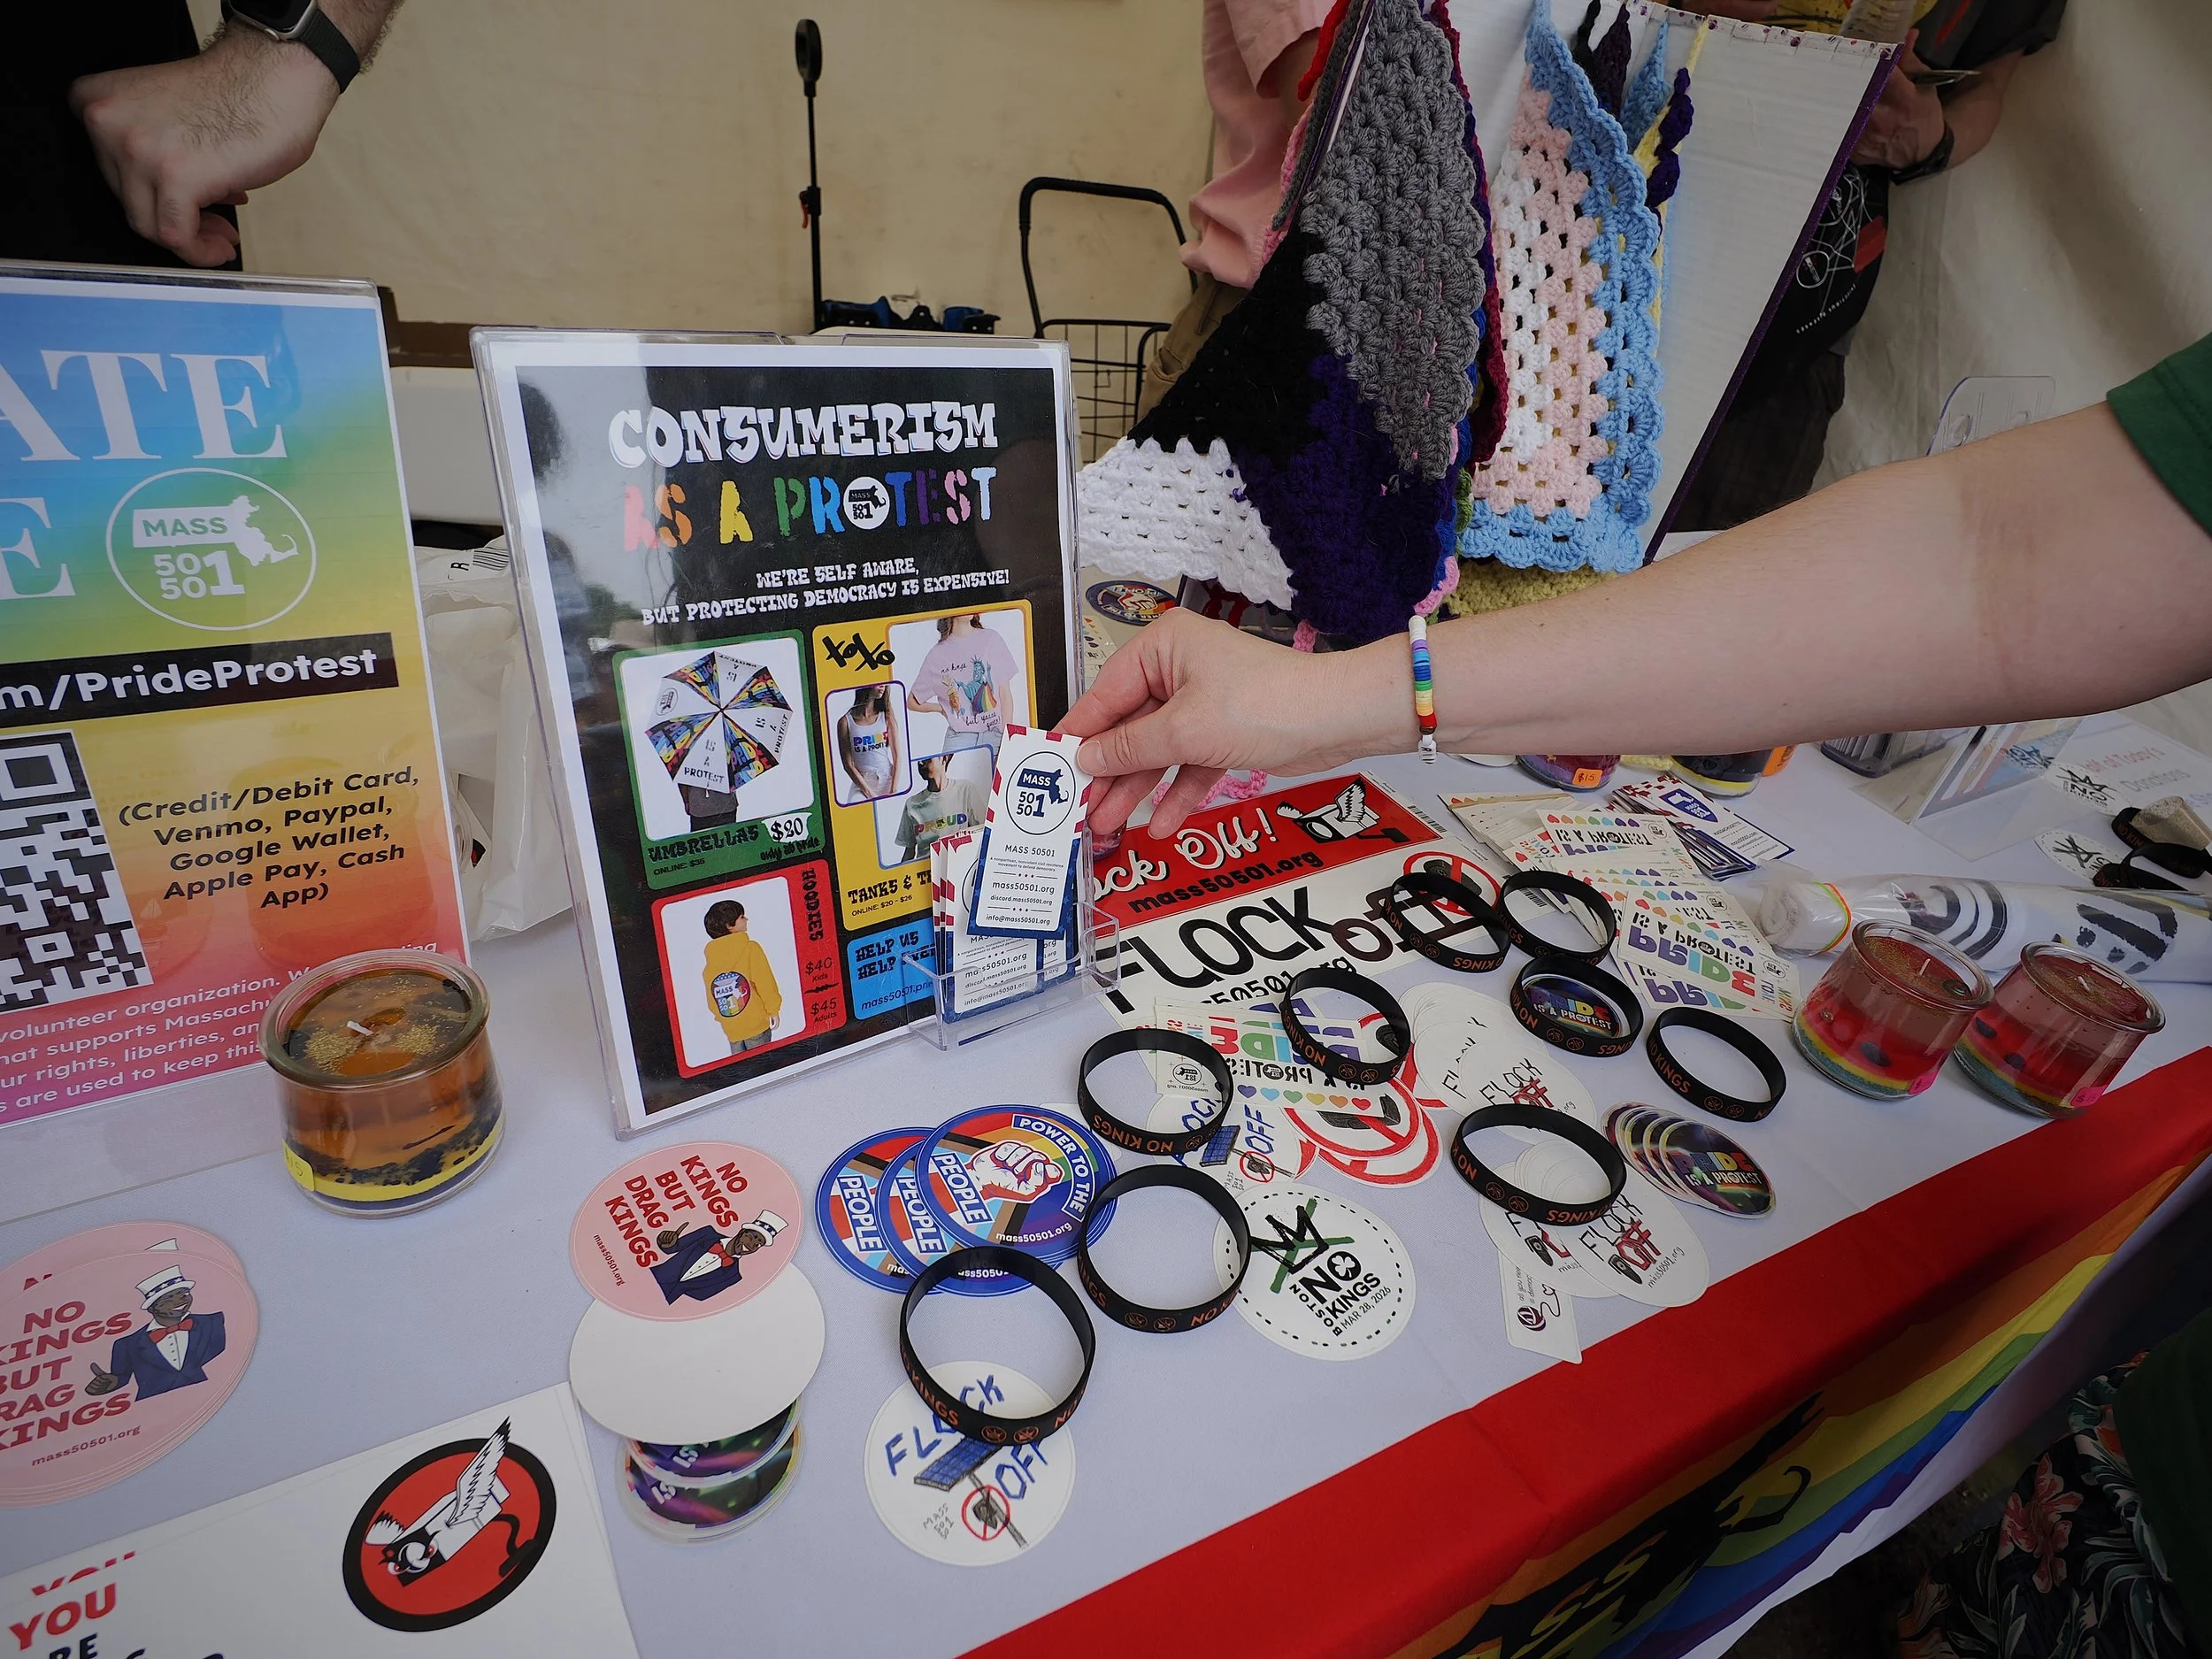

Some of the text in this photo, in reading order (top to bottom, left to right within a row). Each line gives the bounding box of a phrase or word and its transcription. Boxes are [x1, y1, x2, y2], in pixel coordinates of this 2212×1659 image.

[609, 400, 999, 468] CONSUMERISM
[142, 516, 228, 538] MASS
[624, 482, 693, 552] AS
[719, 480, 753, 545] A
[756, 557, 920, 589] WE'RE SELF AWARE,
[641, 568, 1010, 626] BUT PROTECTING DEMOCRACY IS EXPENSIVE!
[119, 765, 419, 827] (Credit/Debit Card,
[1023, 773, 1052, 787] MASS
[1578, 773, 1595, 782] $15
[154, 796, 393, 847] Venmo, Paypal,
[771, 818, 803, 841] $20
[1174, 808, 1277, 869] Off!
[170, 821, 389, 872] Google Wallet,
[648, 825, 759, 863] UMBRELLAS
[689, 858, 705, 867] $35
[1005, 845, 1056, 857] MASS 50501
[164, 845, 405, 902] Apple Pay, Cash
[848, 879, 898, 904] TANKS
[992, 881, 1055, 895] mass50501.org
[1127, 850, 1325, 913] mass50501.org
[260, 883, 329, 910] App)
[801, 867, 824, 941] HOODIES
[880, 895, 913, 909] $20 $26
[990, 895, 1053, 906] discord.mass50501.org
[986, 914, 1050, 926] info@mass50501.org
[855, 931, 919, 963] HELP US
[1095, 886, 1333, 1015] FLOCK
[1452, 956, 1494, 971] KINGS
[856, 956, 896, 980] HELP
[124, 977, 280, 1018] organization.
[716, 986, 733, 996] MASS
[810, 998, 838, 1018] $45
[1531, 986, 1610, 1021] PRIDE
[1533, 1003, 1545, 1013] IS
[46, 998, 268, 1056] supports Massach
[1519, 1008, 1539, 1029] NO
[35, 1055, 117, 1080] rights,
[124, 1027, 225, 1062] liberties,
[232, 1021, 258, 1040] an
[1305, 1048, 1326, 1067] NO
[16, 1049, 219, 1108] are used to keep
[1655, 1054, 1690, 1094] KINGS
[1094, 1113, 1174, 1153] NO KINGS
[1244, 1103, 1275, 1154] OFF
[716, 1161, 749, 1194] NO
[1018, 1118, 1090, 1213] POWER TO THE
[1458, 1156, 1478, 1181] NO
[1671, 1151, 1755, 1174] PRIDE
[624, 1174, 670, 1228] DRAG
[655, 1170, 696, 1211] BUT
[680, 1155, 739, 1228] KINGS
[933, 1154, 987, 1224] PEOPLE
[604, 1195, 659, 1268] KINGS
[841, 1176, 882, 1252] PEOPLE
[995, 1221, 1072, 1244] mass50501.org
[593, 1234, 626, 1286] mass50501.org
[1298, 1251, 1362, 1304] NO
[1647, 1245, 1686, 1288] mass50501.org
[1191, 1305, 1218, 1327] NO
[1289, 1284, 1343, 1336] BOSTON
[1325, 1273, 1380, 1319] KINGS
[1340, 1286, 1391, 1329] MAR 28, 2026
[22, 1300, 87, 1334] NO
[31, 1424, 142, 1466] mass50501.org
[8, 1582, 117, 1651] YOU
